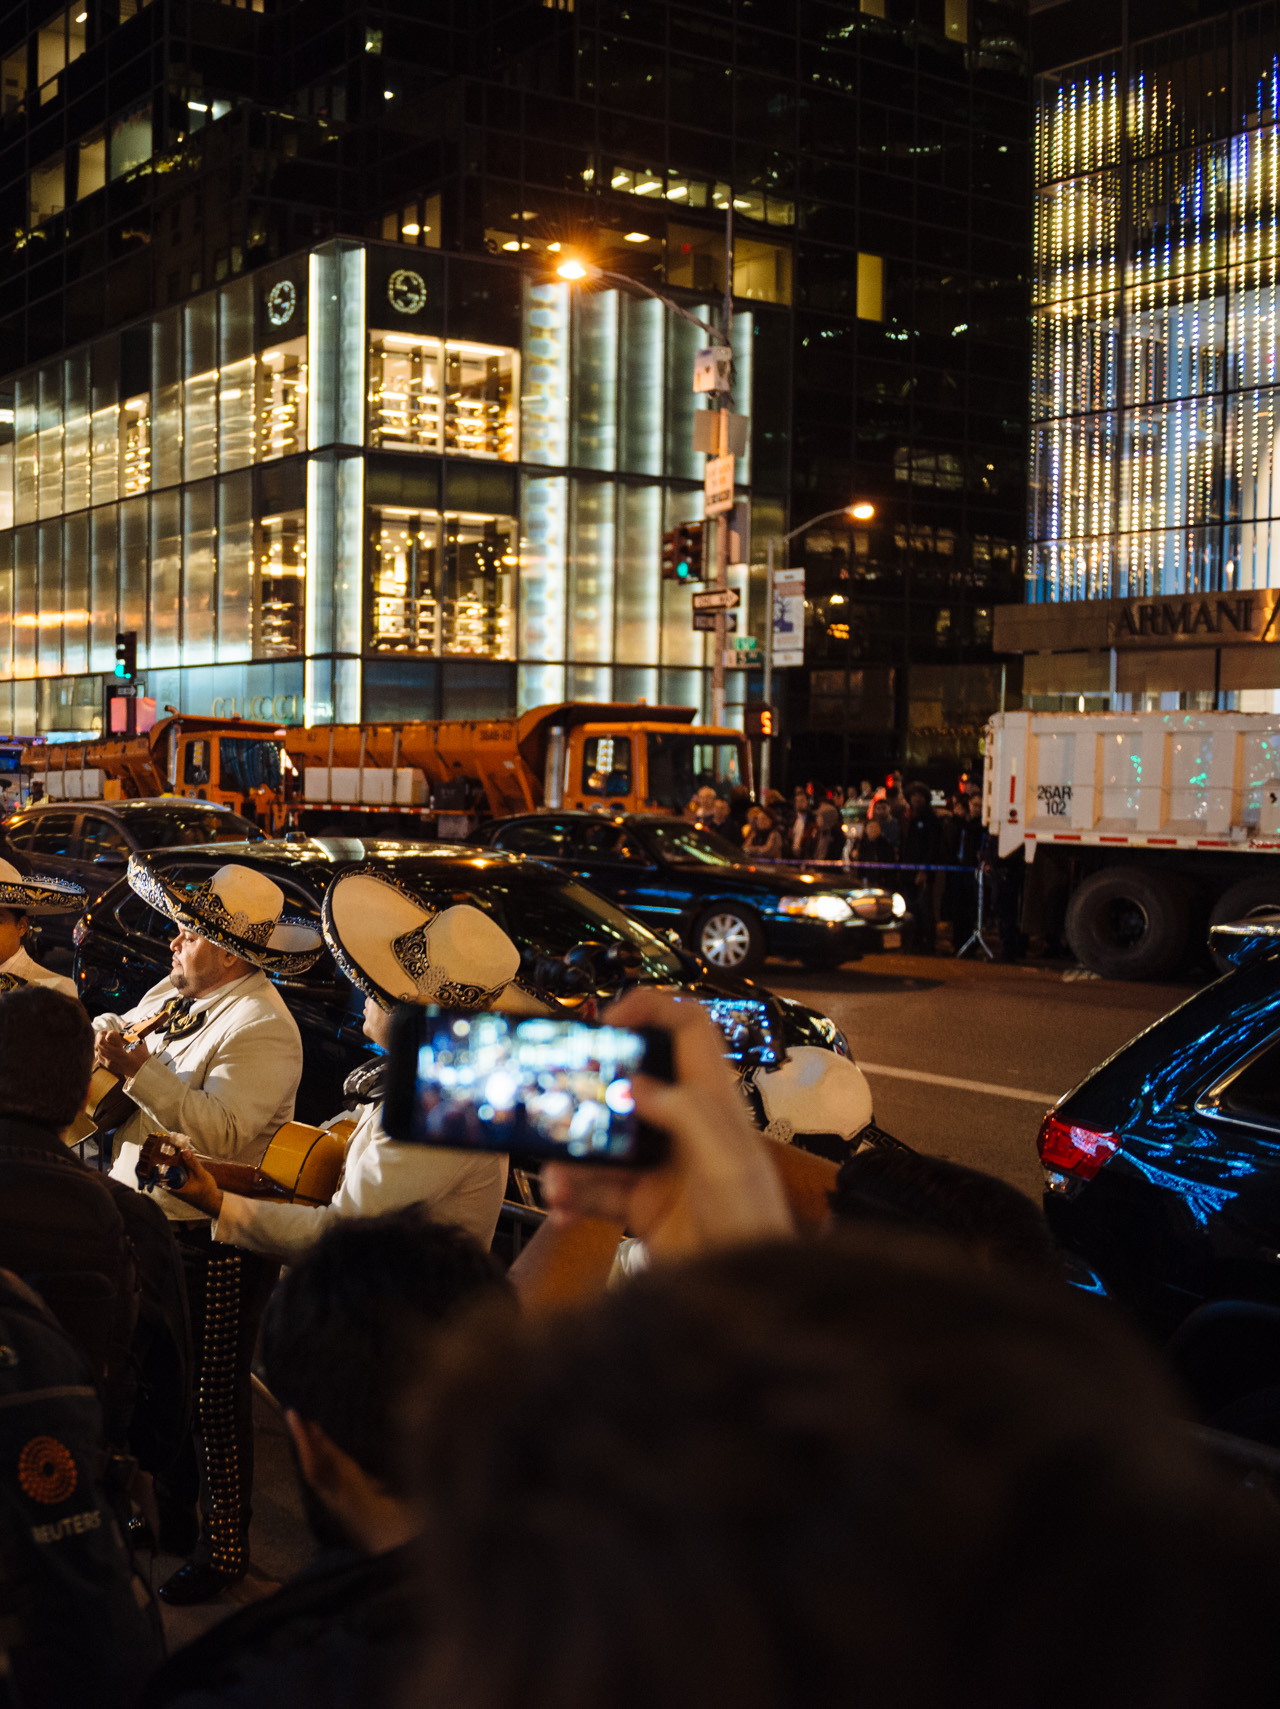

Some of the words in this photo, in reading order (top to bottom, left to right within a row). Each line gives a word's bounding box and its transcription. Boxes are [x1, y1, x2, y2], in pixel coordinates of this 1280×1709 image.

[1115, 599, 1253, 637] ARMANI
[212, 694, 298, 720] GUCCI
[1046, 800, 1066, 815] 102
[31, 1510, 102, 1543] REUTERS
